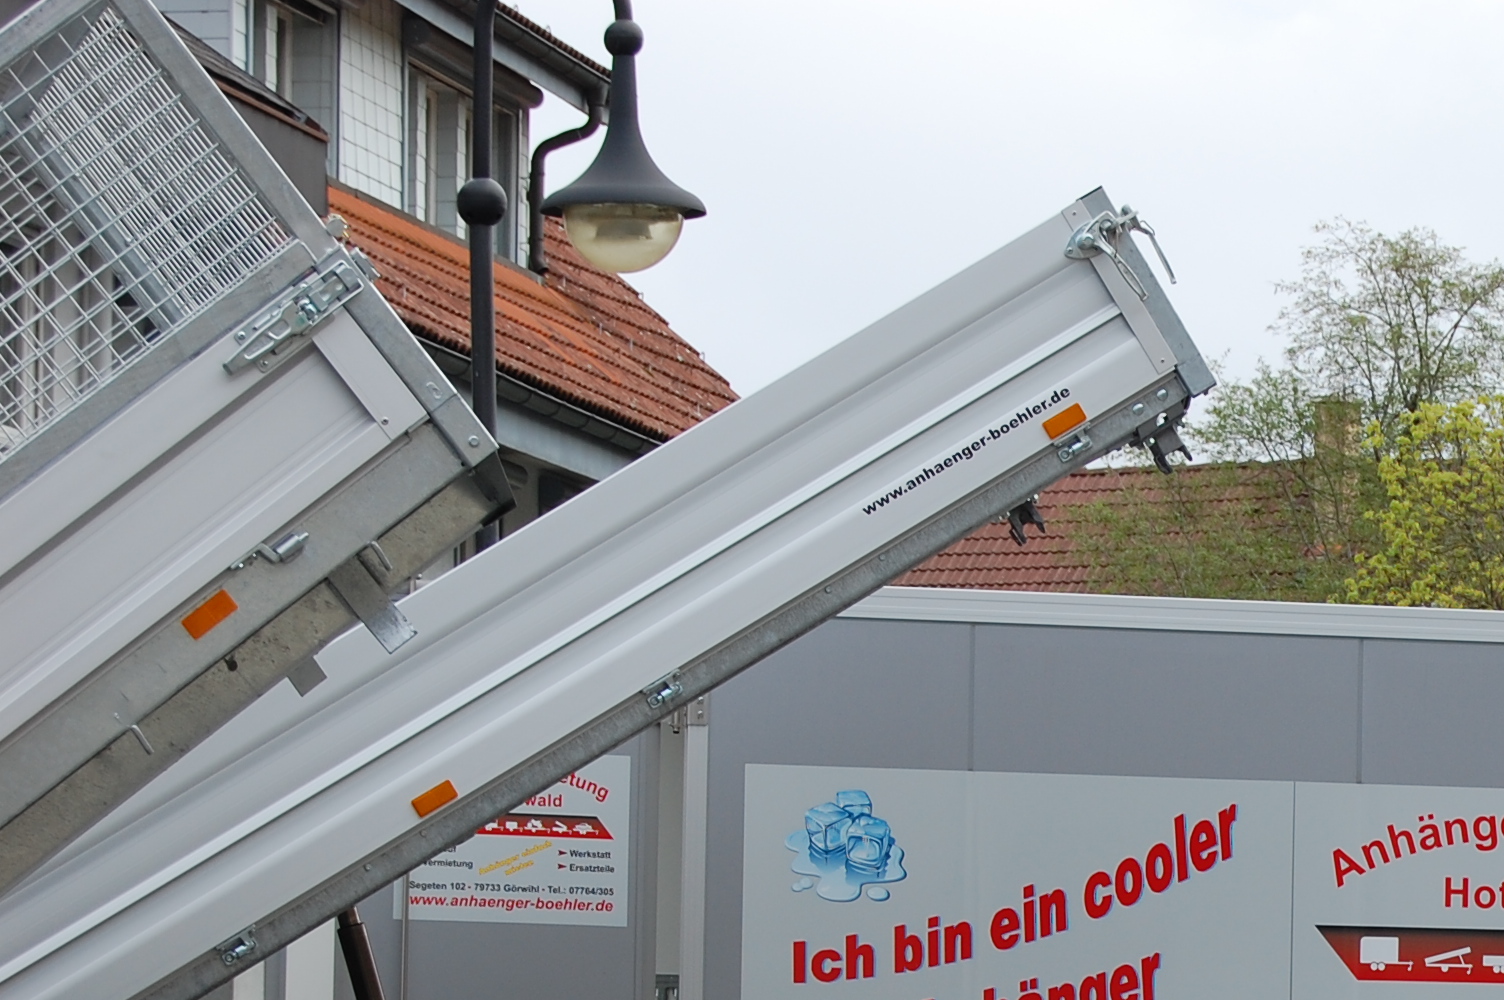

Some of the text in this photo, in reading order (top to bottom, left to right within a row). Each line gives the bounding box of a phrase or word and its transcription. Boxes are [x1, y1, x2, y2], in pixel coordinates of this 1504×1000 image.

[863, 386, 1070, 515] www.anhaenger-boehler.de
[570, 850, 611, 858] Werkstatt
[570, 864, 614, 872] Ersatzteile
[409, 881, 447, 891] Segeten
[451, 882, 465, 890] 102
[474, 883, 500, 891] 79733
[504, 884, 539, 893] Görwihl
[792, 803, 1237, 984] Ich bin ein cooler
[409, 894, 614, 912] www.anhaenger-boehler.de
